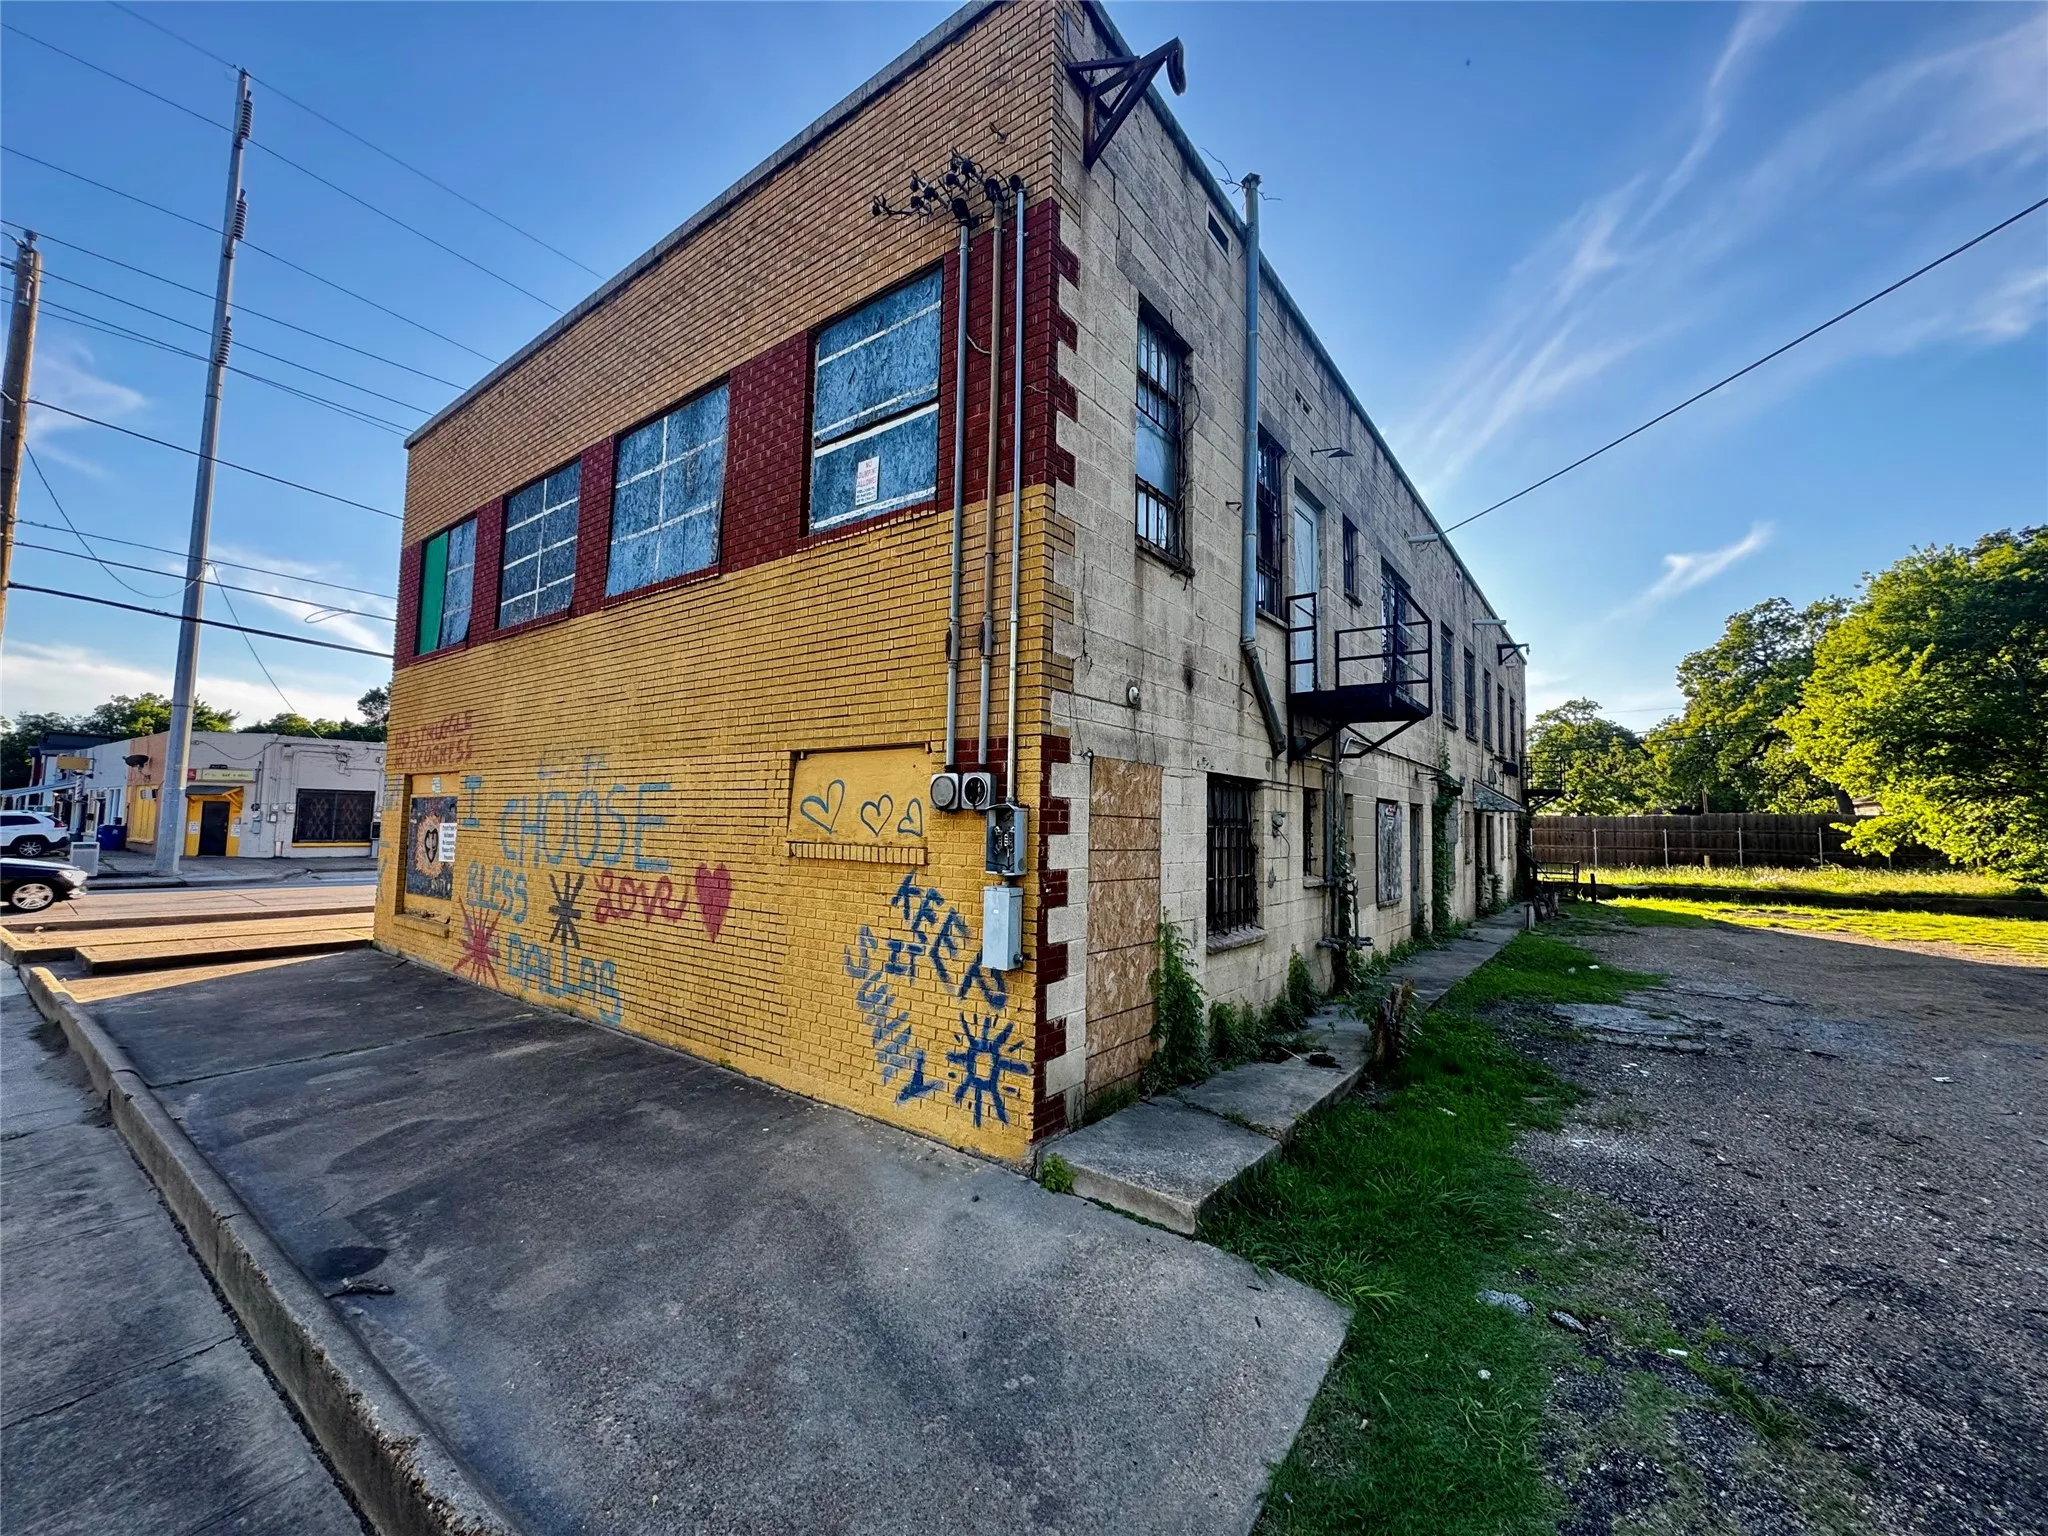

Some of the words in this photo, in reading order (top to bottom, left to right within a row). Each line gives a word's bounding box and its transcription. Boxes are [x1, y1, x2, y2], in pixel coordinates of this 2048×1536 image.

[410, 735, 474, 771] PROGRESS
[460, 776, 483, 828] I
[500, 783, 672, 871] CHOOSE
[465, 860, 529, 924] BLESS
[507, 932, 623, 1027] DALLAS
